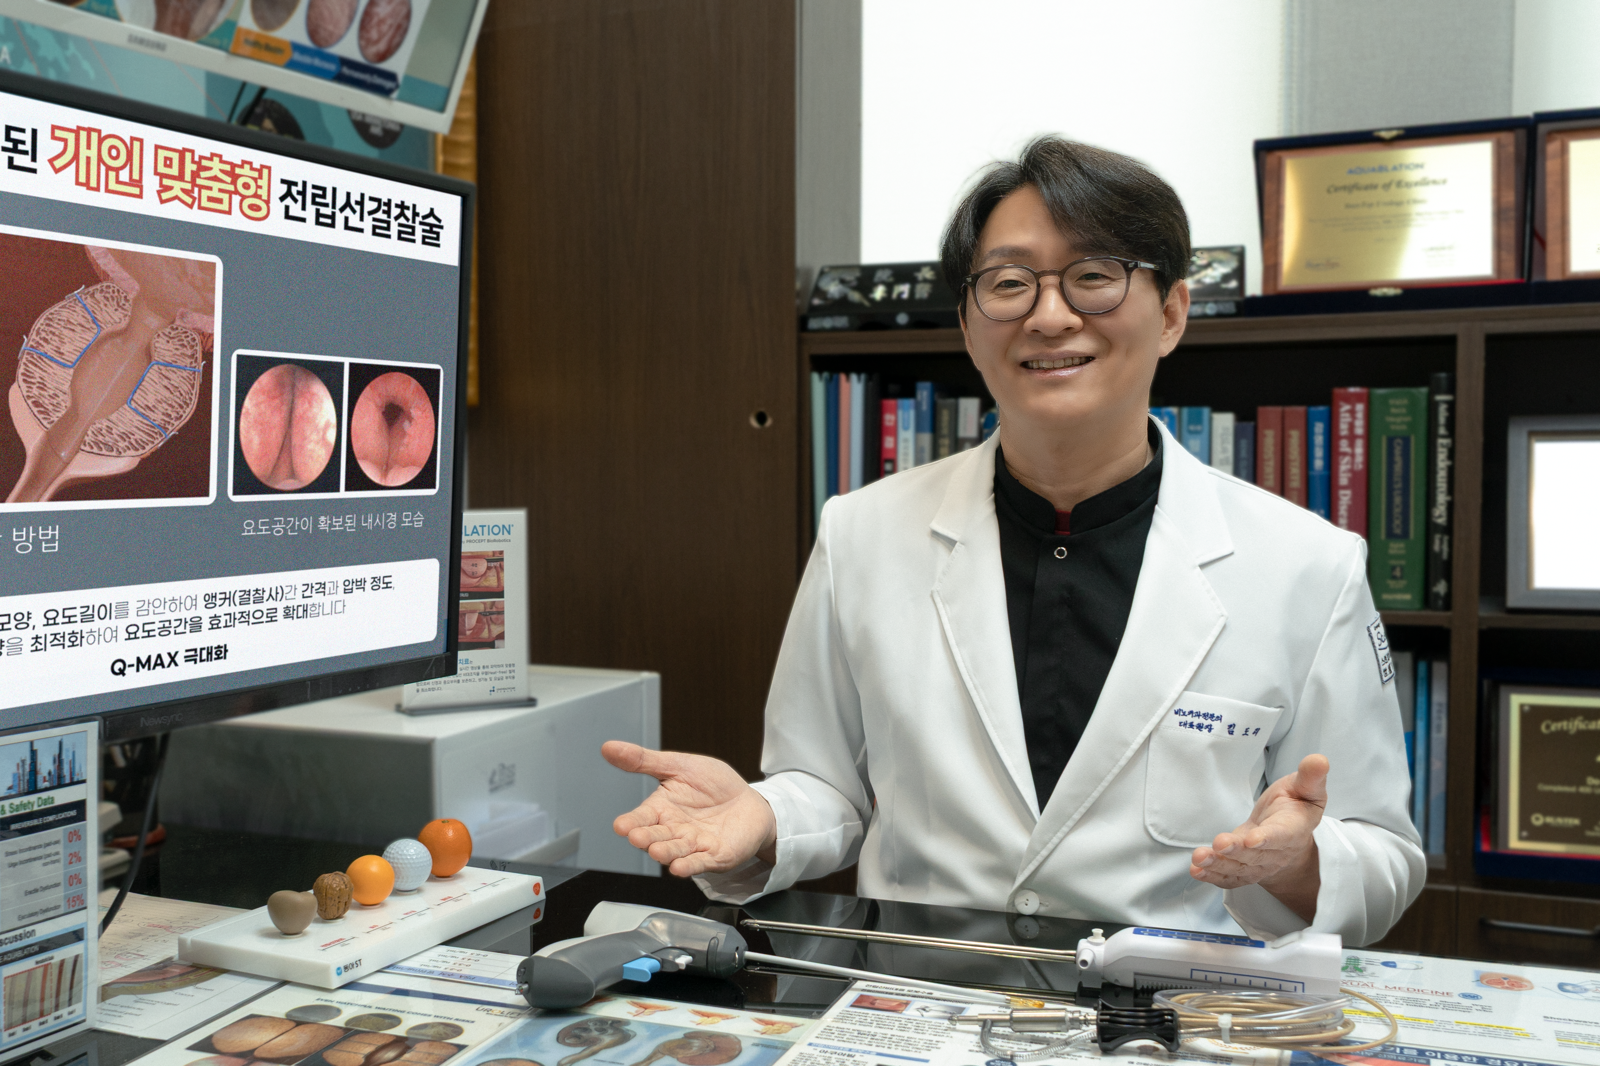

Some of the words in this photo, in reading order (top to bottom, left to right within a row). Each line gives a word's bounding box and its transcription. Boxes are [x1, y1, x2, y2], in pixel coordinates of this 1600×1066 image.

[1346, 161, 1425, 176] AQUABLATION
[1, 124, 38, 174] 된
[48, 124, 143, 199] 개인
[153, 144, 271, 222] 맞춤형
[278, 178, 444, 248] 전립선결찰술
[1326, 181, 1379, 195] Certificate
[1381, 178, 1394, 193] of
[1395, 177, 1448, 190] Excellence
[1338, 402, 1352, 436] Atlas
[1338, 439, 1353, 453] of
[1338, 455, 1353, 486] Skin
[1432, 437, 1452, 526] Endourology
[241, 516, 313, 536] 요도공간이
[317, 513, 357, 533] 확보된
[361, 512, 397, 530] 내시경
[401, 511, 425, 527] 모습
[462, 524, 511, 537] LATION
[12, 525, 60, 554] 방법
[42, 601, 130, 627] 요도길이를
[136, 594, 198, 617] 감안하여
[203, 584, 298, 610] 앵커(결찰사)간
[301, 580, 339, 599] 간격과
[342, 578, 367, 594] 압박
[370, 575, 395, 591] 정도,
[30, 625, 118, 653] 최적화하여
[124, 615, 203, 641] 요도공간을
[208, 607, 279, 631] 효과적으로
[282, 599, 346, 621] 확대합니다
[110, 651, 179, 677] Q-MAX
[183, 644, 229, 665] 극대화
[9, 799, 35, 813] Safety
[37, 795, 55, 808] Data
[10, 817, 43, 830] IRREVERSIBLE
[43, 810, 77, 824] COMPLICATIONS
[68, 829, 82, 843] 0%
[68, 851, 82, 865] 2%
[68, 872, 82, 887] 0%
[66, 894, 85, 909] 15%
[1384, 985, 1454, 997] MEDICINE
[1425, 1050, 1480, 1063] 이용한
